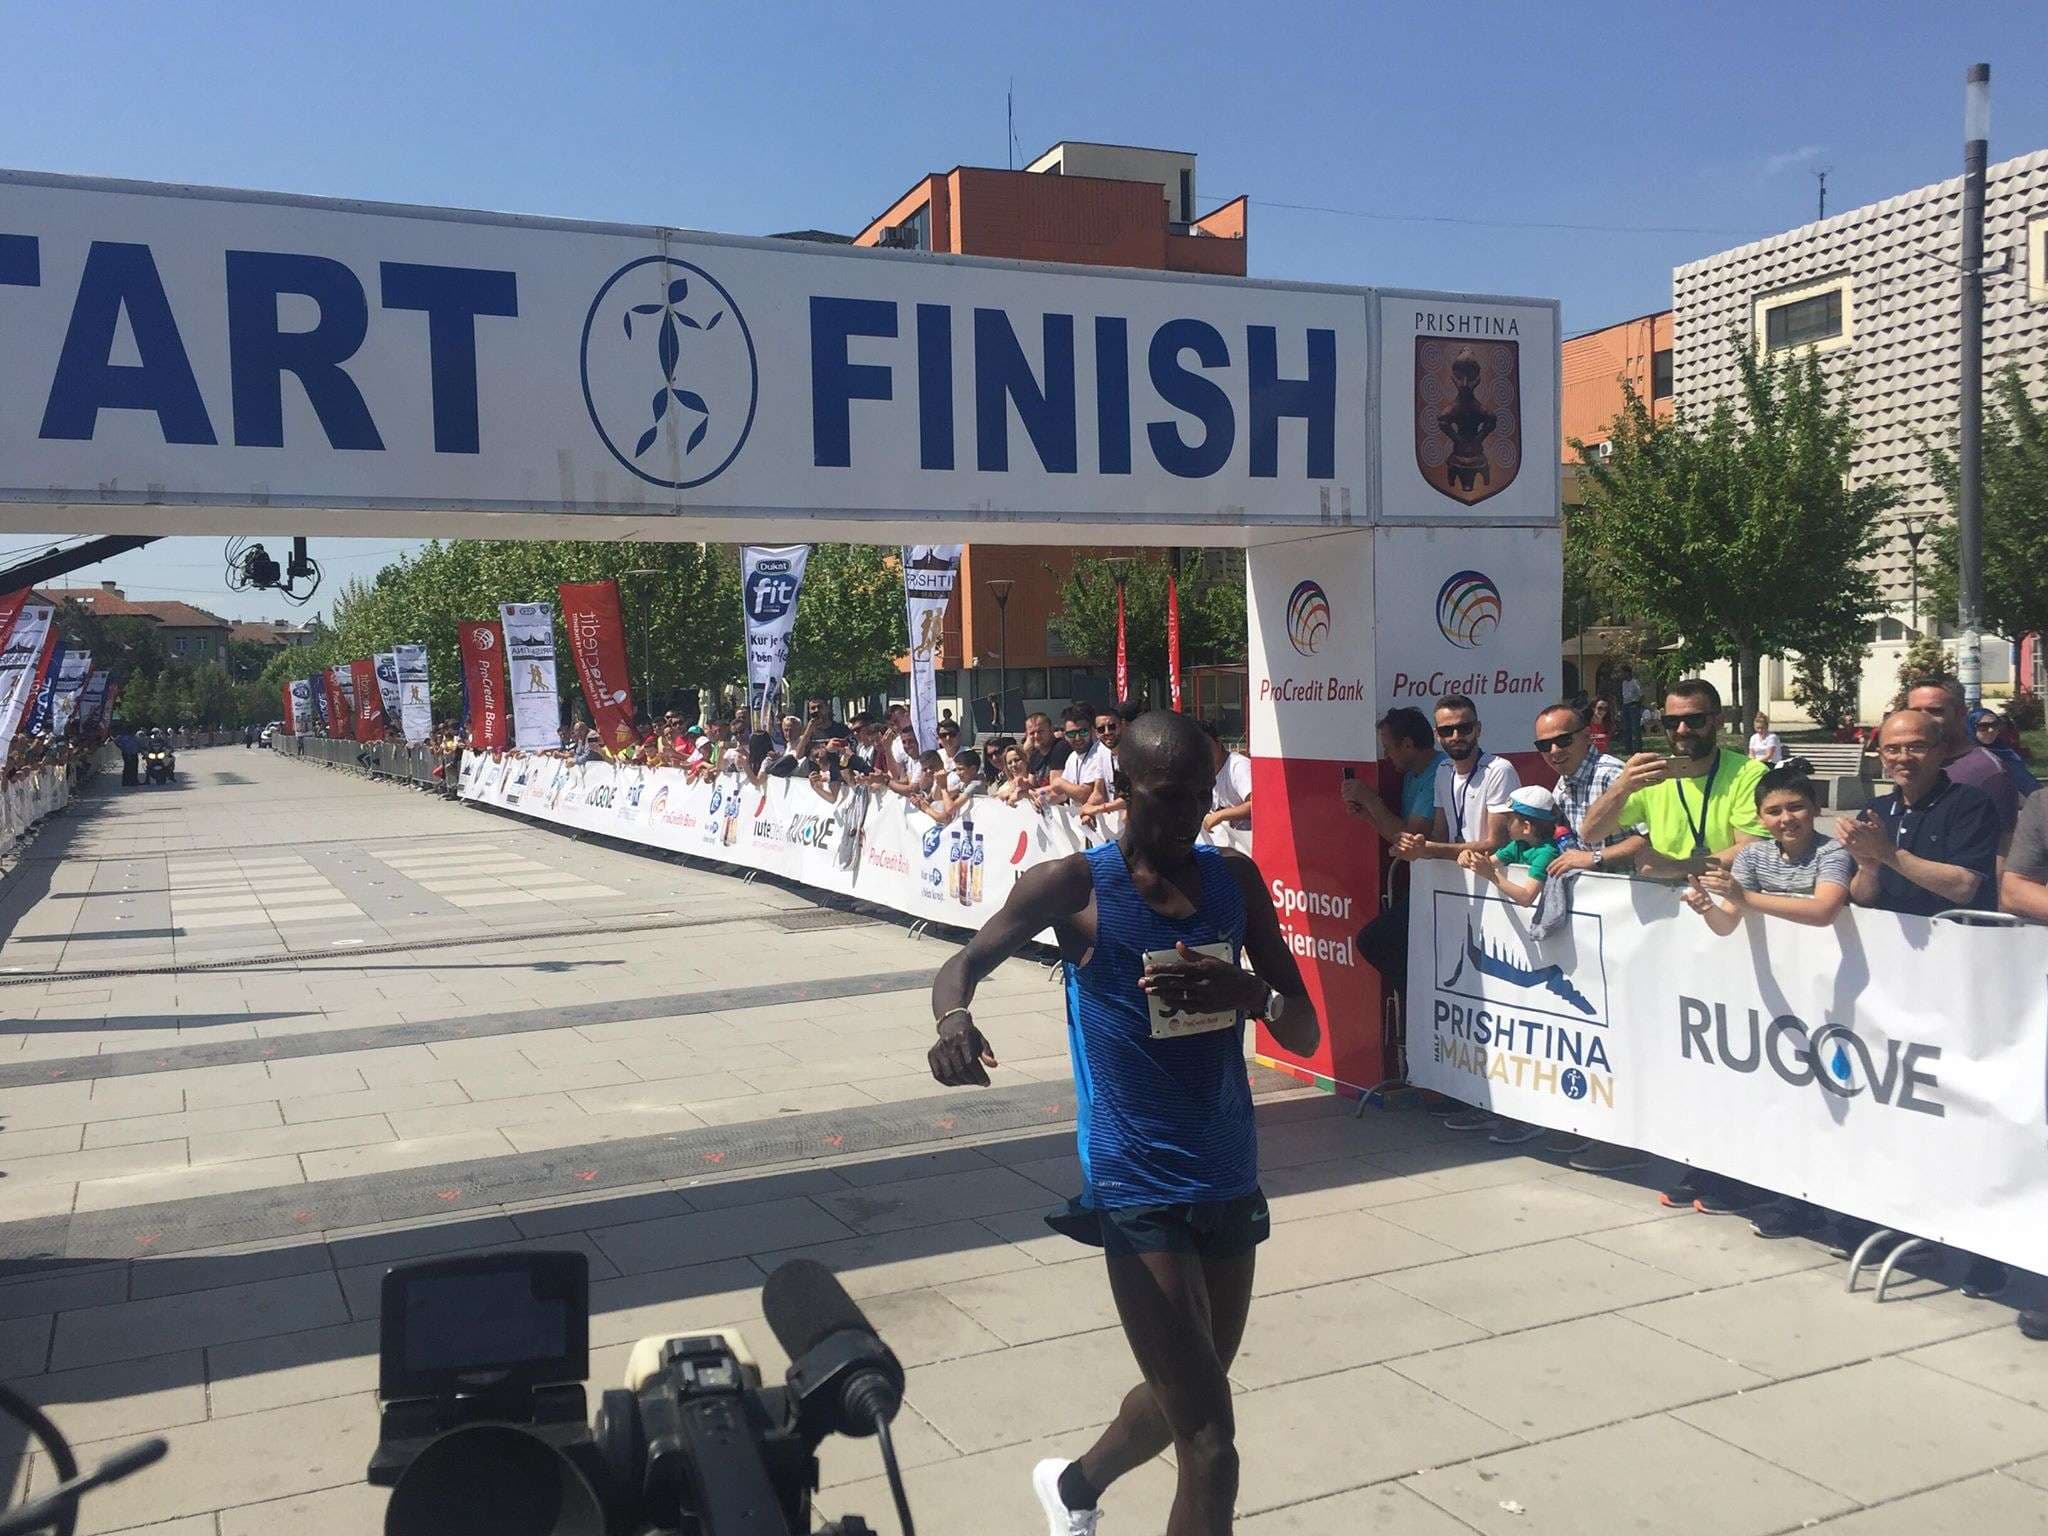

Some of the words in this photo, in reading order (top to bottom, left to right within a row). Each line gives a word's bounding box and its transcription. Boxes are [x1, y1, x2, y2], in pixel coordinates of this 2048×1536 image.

[1415, 312, 1520, 336] PRISHTINA
[0, 234, 518, 454] ART
[810, 296, 1337, 480] FINISH
[760, 562, 787, 571] Dukat
[906, 573, 955, 588] RISHTI
[753, 577, 792, 614] fit
[750, 634, 769, 646] Kur
[478, 660, 497, 709] ProCredit
[1260, 678, 1323, 701] ProCredit
[1327, 678, 1364, 701] Bank
[1393, 670, 1488, 698] ProCredit
[1494, 669, 1545, 695] Bank
[484, 709, 497, 740] Bank
[1272, 879, 1352, 919] Sponsor
[1434, 999, 1612, 1073] PRISHTINA
[1440, 1036, 1615, 1109] MARATHON
[1679, 995, 1945, 1117] RUGOVE
